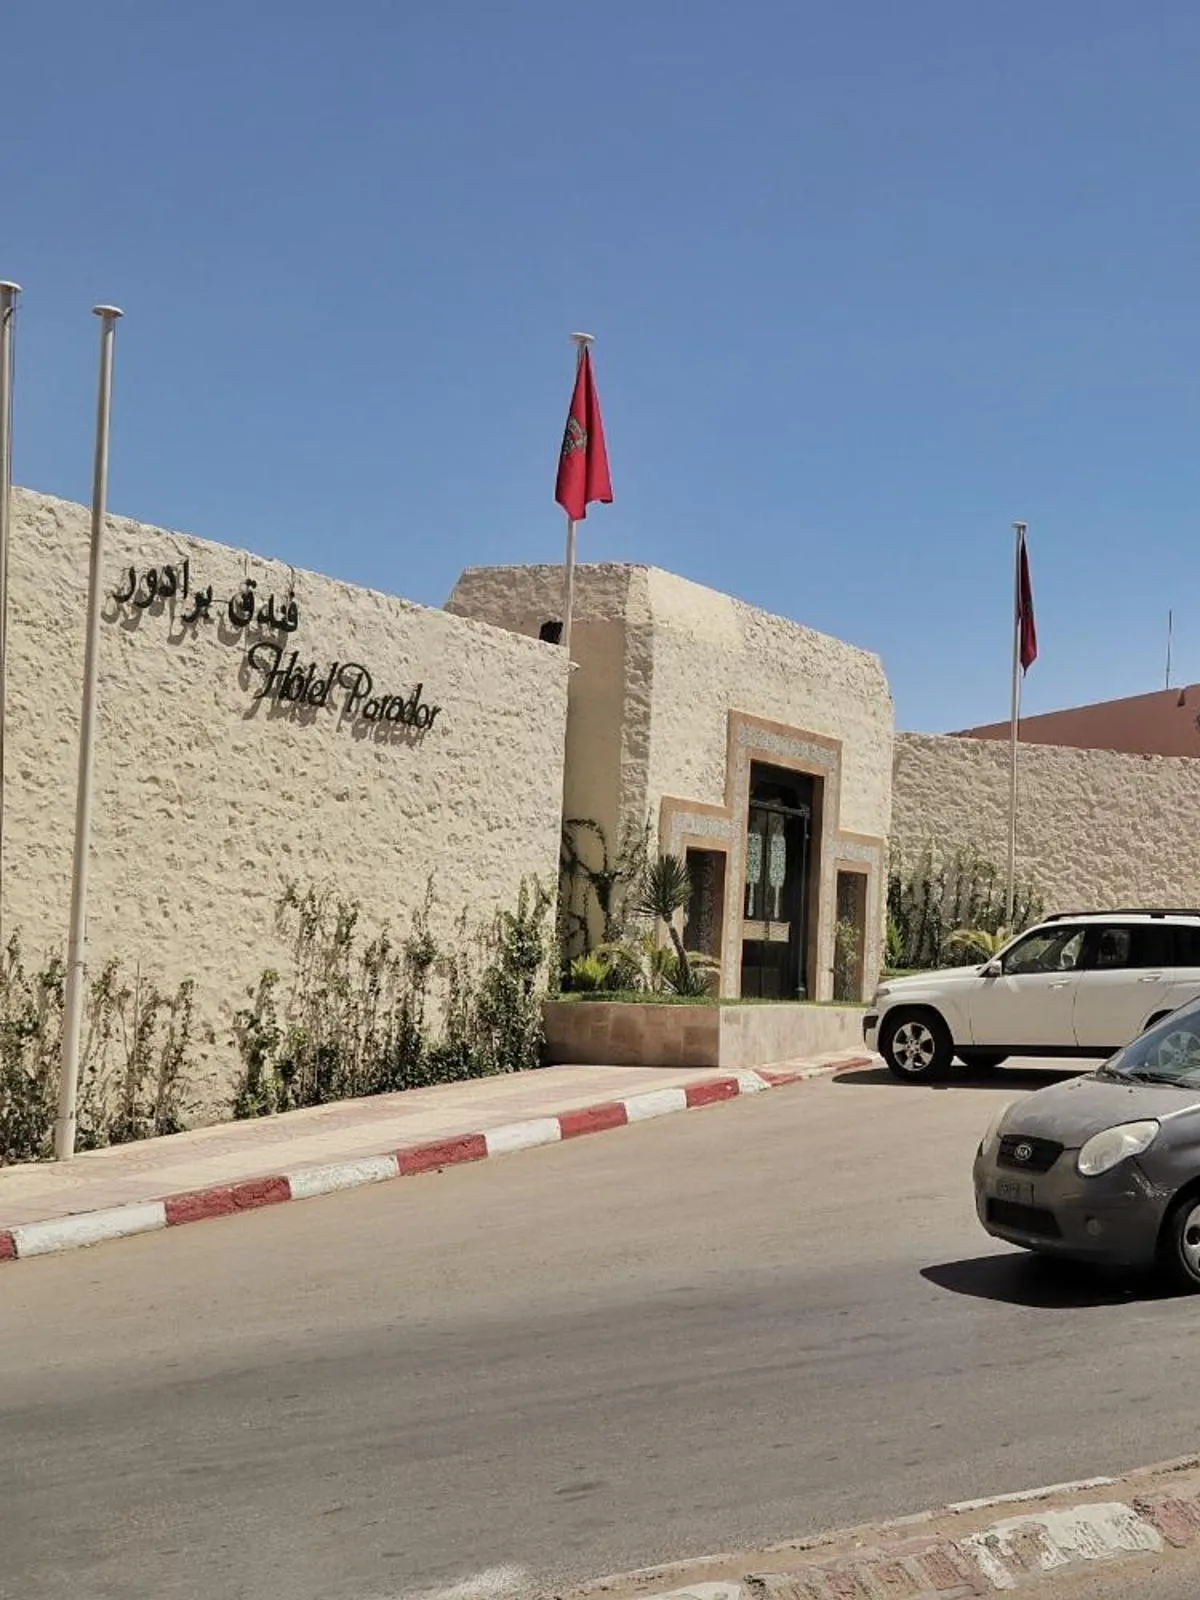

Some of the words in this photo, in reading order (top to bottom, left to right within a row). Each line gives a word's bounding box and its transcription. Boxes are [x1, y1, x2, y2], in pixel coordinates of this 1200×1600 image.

[228, 577, 299, 633] فندق
[248, 641, 339, 707] Hôtel
[336, 662, 442, 730] Parador
